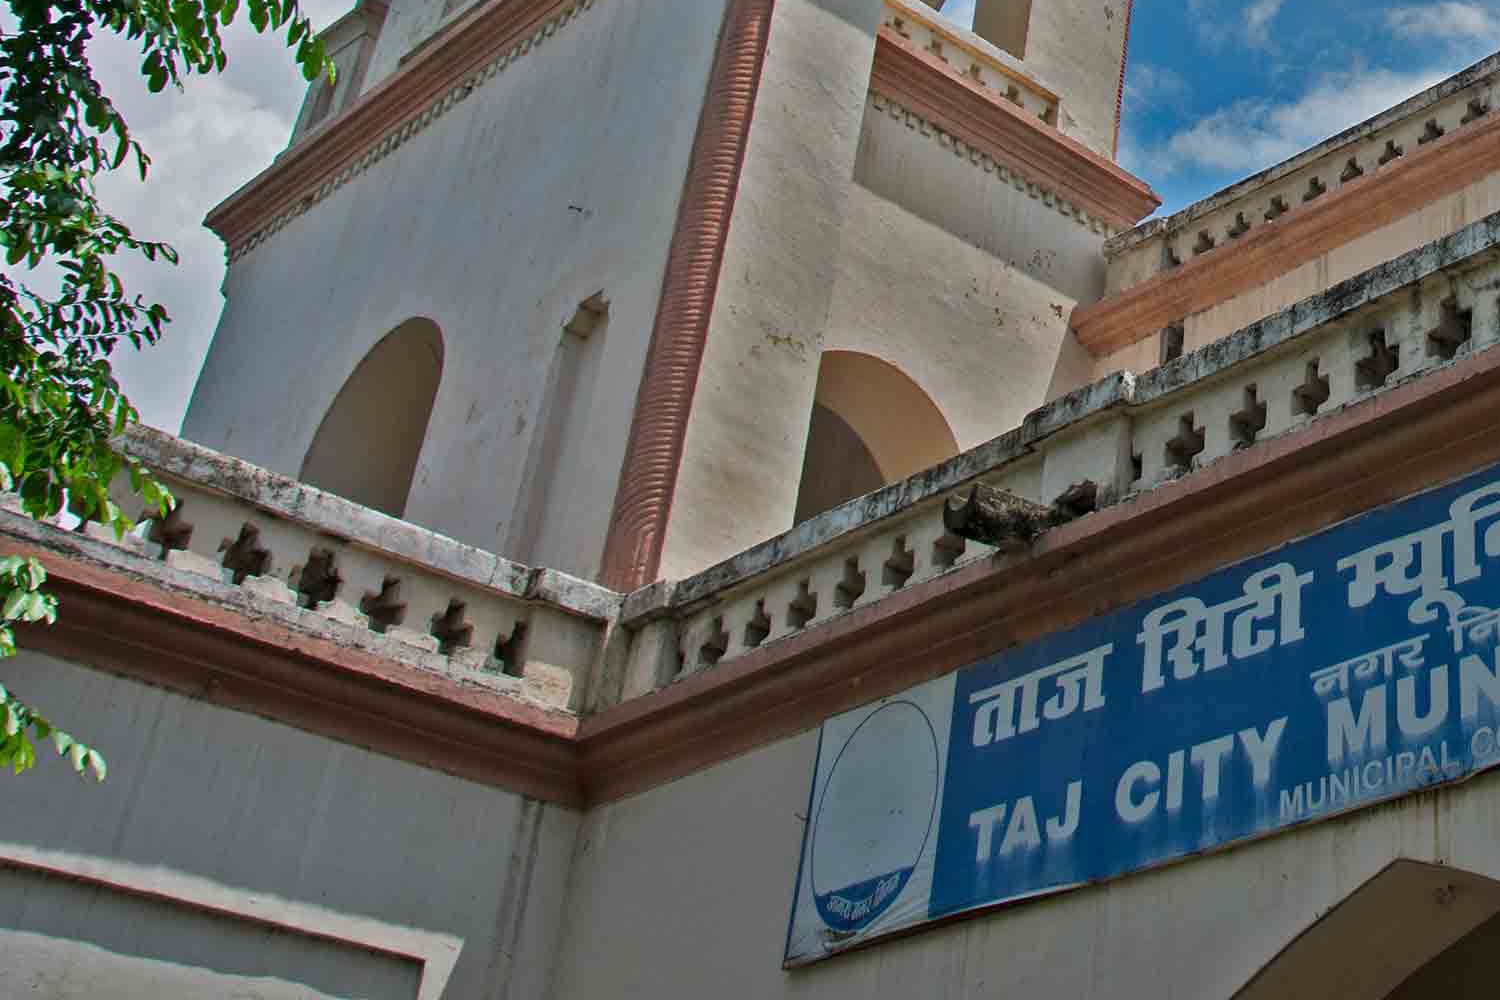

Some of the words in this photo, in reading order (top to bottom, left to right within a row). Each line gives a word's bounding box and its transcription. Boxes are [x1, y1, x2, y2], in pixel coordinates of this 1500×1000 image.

[970, 644, 1112, 746] ताज
[1137, 563, 1313, 693] सिटी
[1310, 633, 1430, 698] नगर
[969, 780, 1082, 862] TAJ
[1115, 716, 1288, 823] CITY
[1279, 740, 1460, 820] MUNICIPAL
